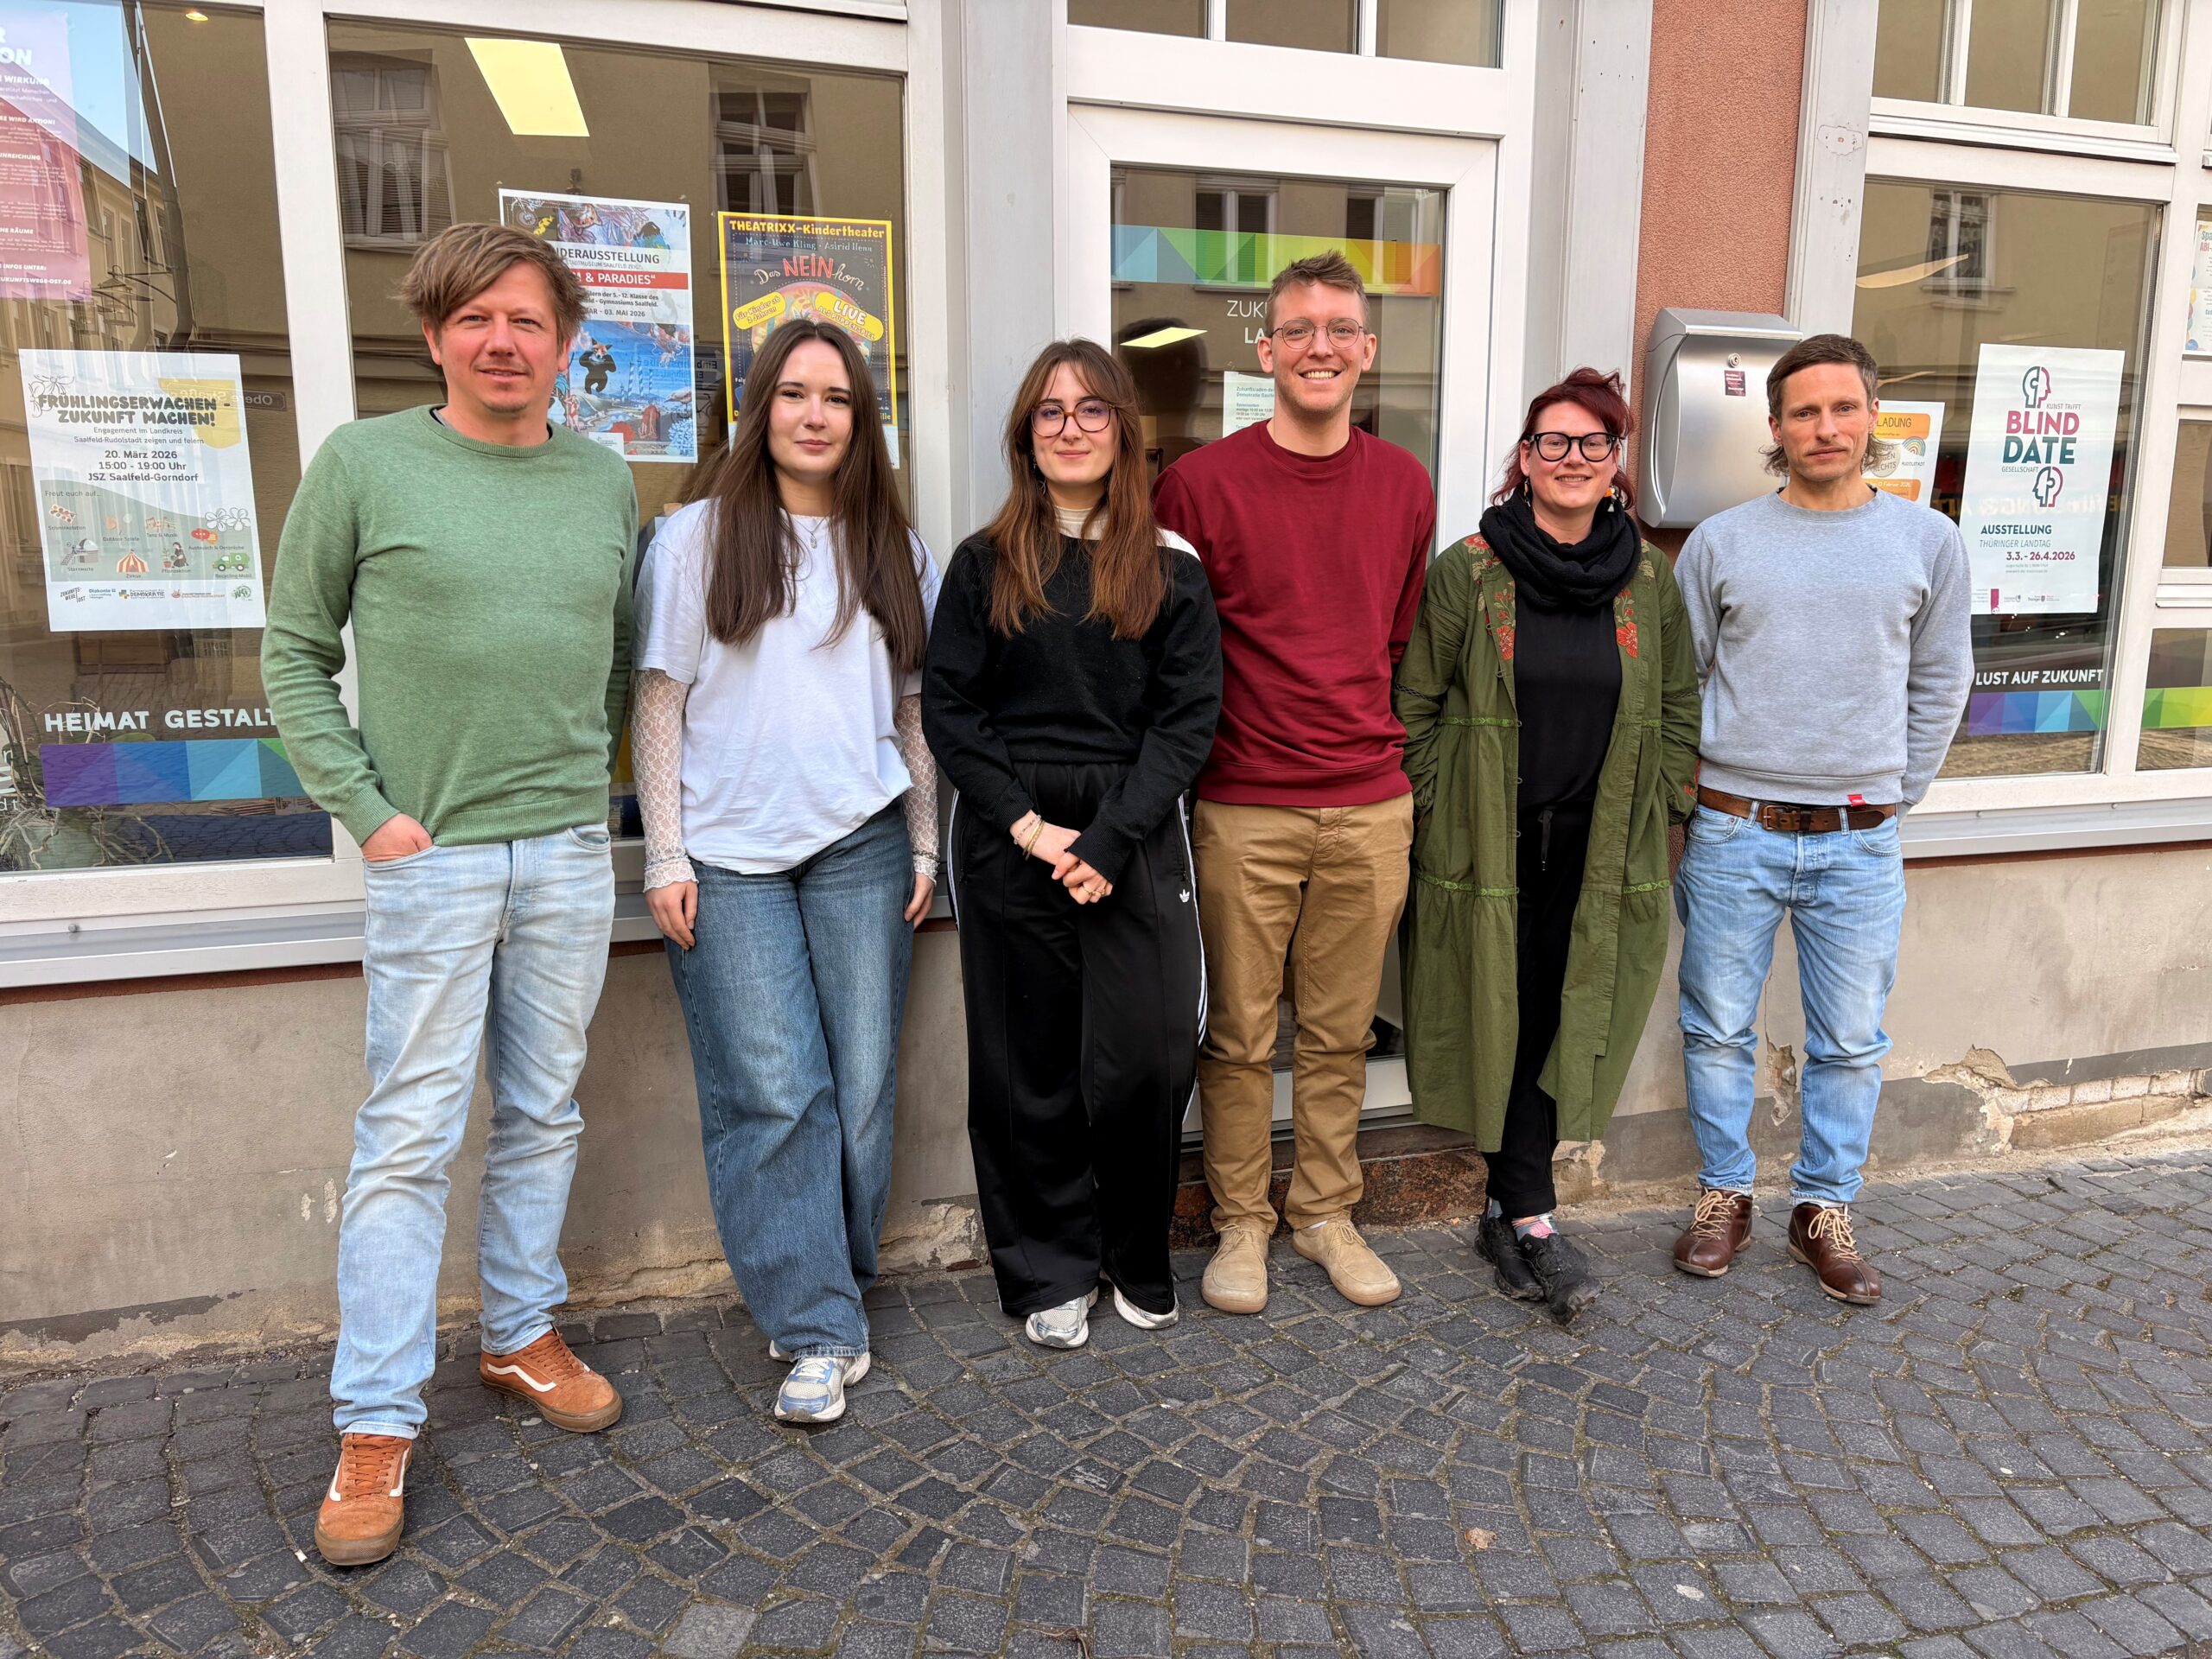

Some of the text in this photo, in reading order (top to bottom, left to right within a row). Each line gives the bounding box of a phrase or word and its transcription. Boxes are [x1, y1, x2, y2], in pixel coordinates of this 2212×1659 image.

[4, 75, 50, 86] WIRKUNG
[729, 220, 885, 238] THEATRIXX-Kindertheater
[746, 237, 872, 251] Marc-Uwe Kling Astrid Henn
[566, 259, 602, 268] STADTMUSEUM
[585, 272, 594, 283] &
[753, 268, 781, 285] Das
[747, 300, 772, 315] Kinder
[772, 296, 781, 305] ab
[833, 299, 867, 326] LIVE
[753, 306, 777, 322] Jahren
[818, 306, 875, 340] ALS PUPPENSPIEL
[37, 392, 217, 411] FRÜHLINGSERWACHEN
[57, 410, 216, 427] ZUKUNFT MACHEN!
[2005, 410, 2080, 435] BLIND
[93, 426, 137, 435] Engagement
[73, 435, 142, 444] Saalfeld-Rudolstadt
[143, 437, 167, 446] zeigen
[105, 448, 178, 460] 20. März 2026
[2002, 435, 2077, 465] DATE
[98, 461, 127, 471] 15:00
[137, 461, 165, 471] 19:00
[168, 462, 187, 471] Uhr
[88, 473, 199, 483] JSZ Saalfeld-Gorndorf
[1980, 524, 2052, 535] AUSSTELLUNG
[1980, 538, 2051, 548] THÜRINGER LANDTAG
[1975, 669, 2104, 686] LUST AUF ZUKUNFT
[44, 711, 149, 733] HEIMAT
